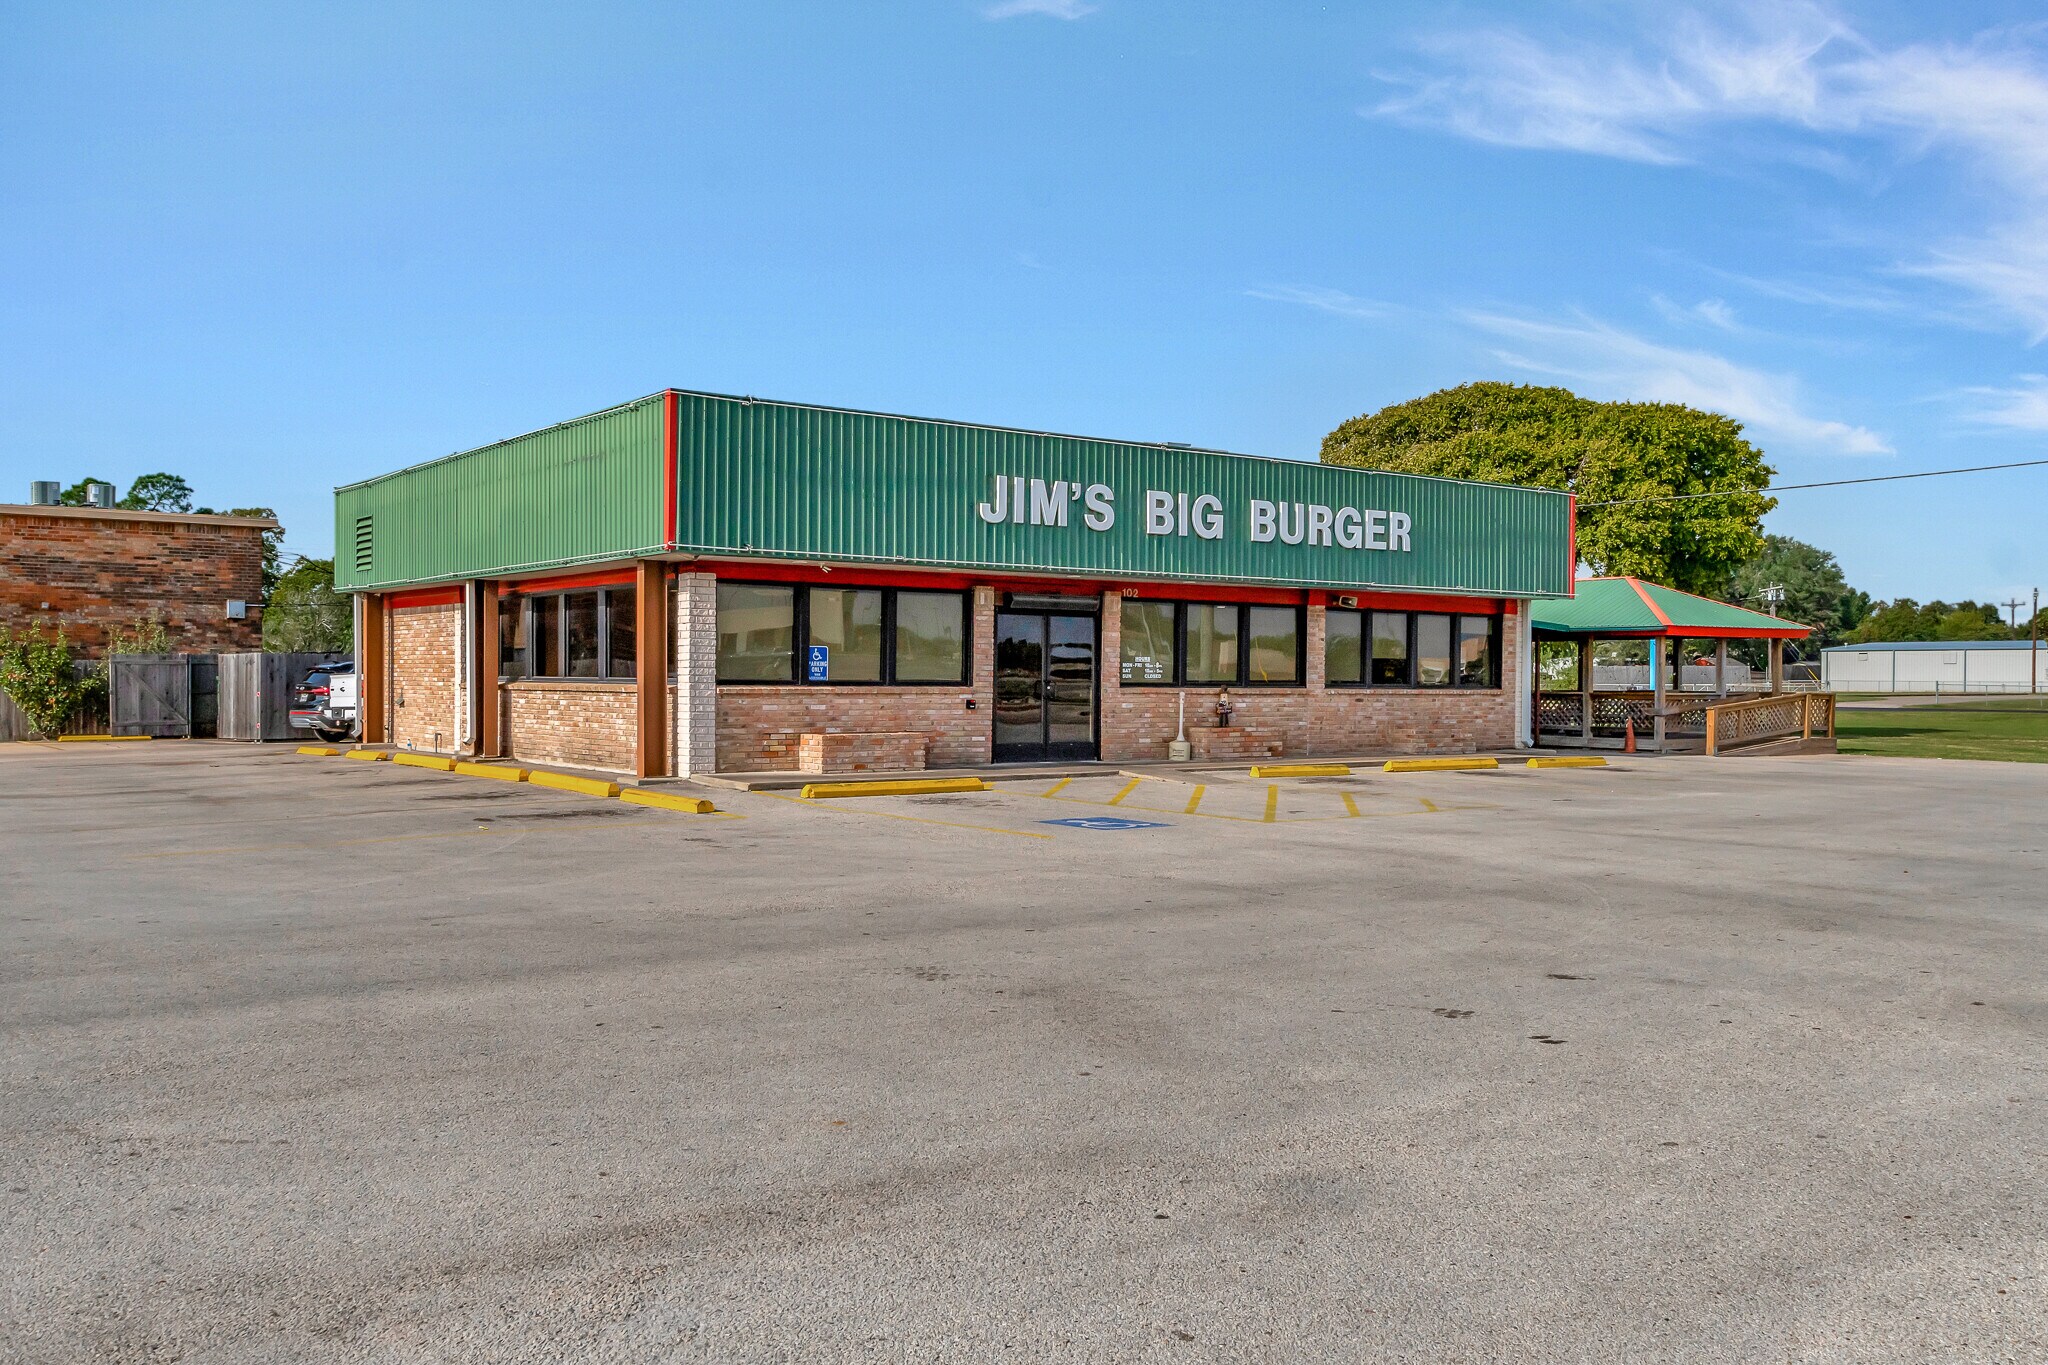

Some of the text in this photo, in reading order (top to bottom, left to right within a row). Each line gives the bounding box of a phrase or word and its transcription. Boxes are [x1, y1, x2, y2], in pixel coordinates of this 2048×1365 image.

[979, 474, 1412, 552] JIM'S BIG BURGER
[1122, 588, 1139, 598] 102
